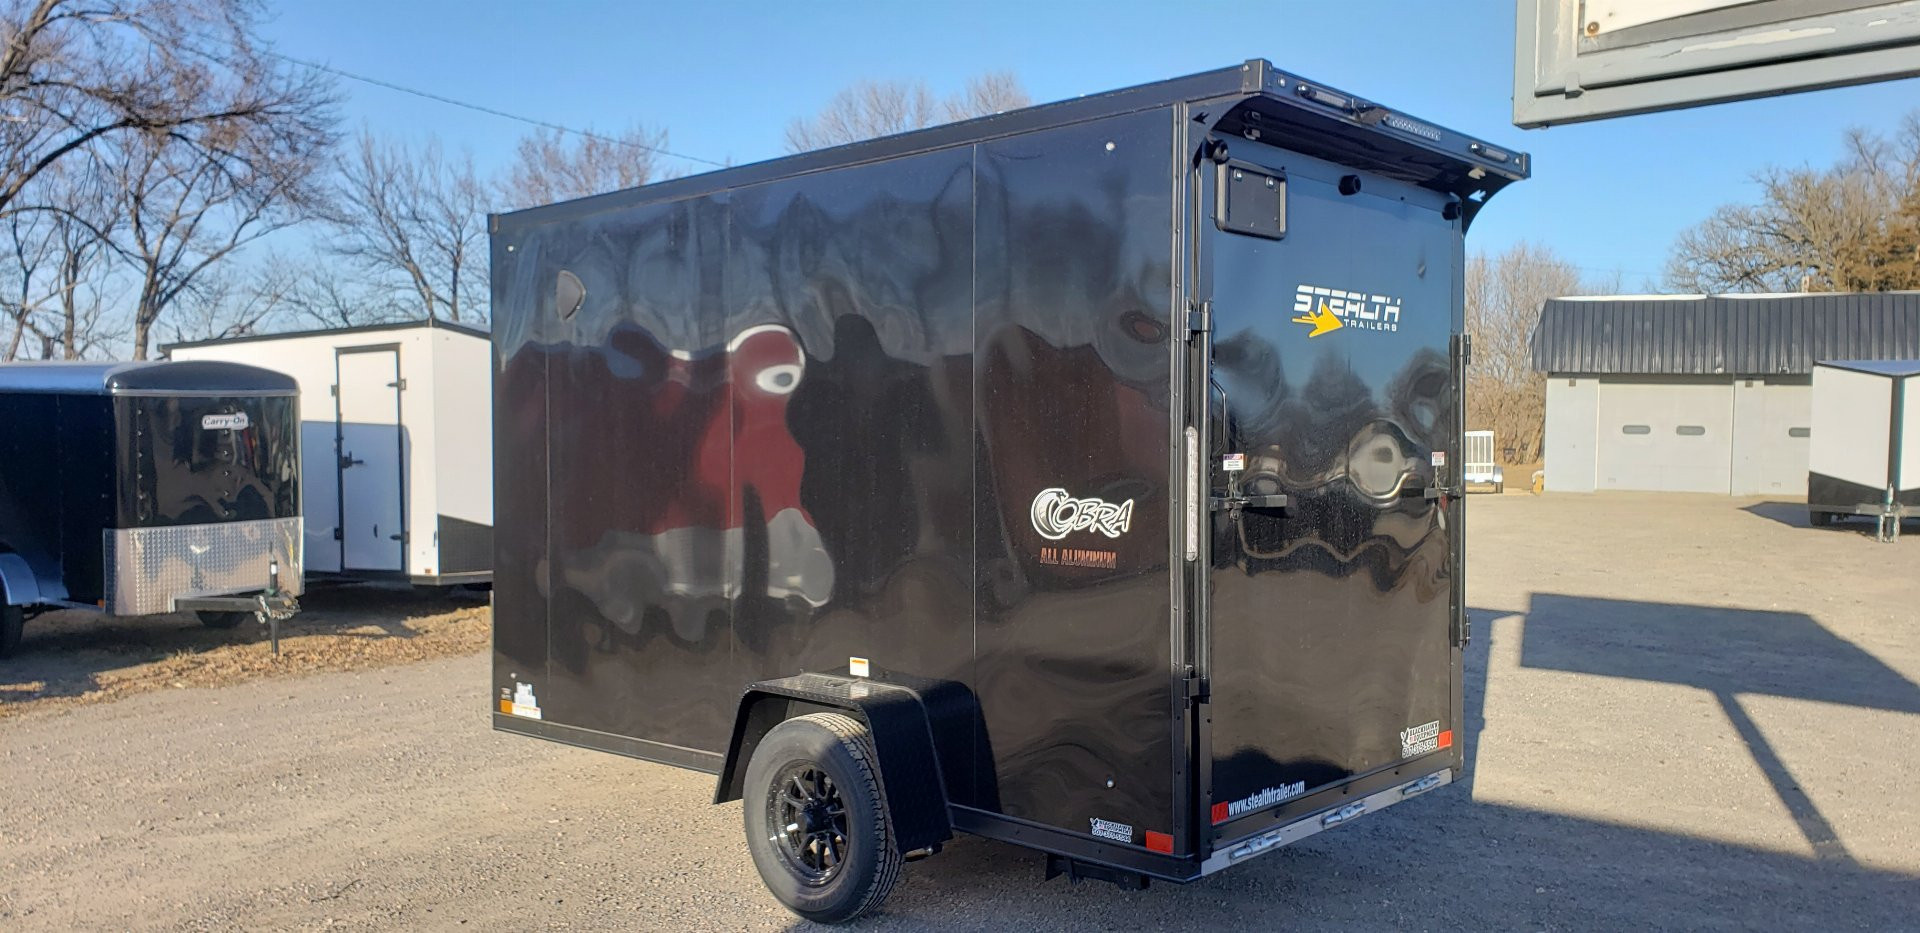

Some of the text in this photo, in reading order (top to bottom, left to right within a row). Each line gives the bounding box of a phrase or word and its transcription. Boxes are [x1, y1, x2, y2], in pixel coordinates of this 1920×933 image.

[1294, 285, 1401, 323] STEALTH
[1344, 319, 1397, 332] TRAILERS
[204, 416, 245, 428] Carry-On
[1040, 547, 1117, 569] ALL ALUMINUM
[1228, 780, 1305, 816] www.stealthtrailer.com
